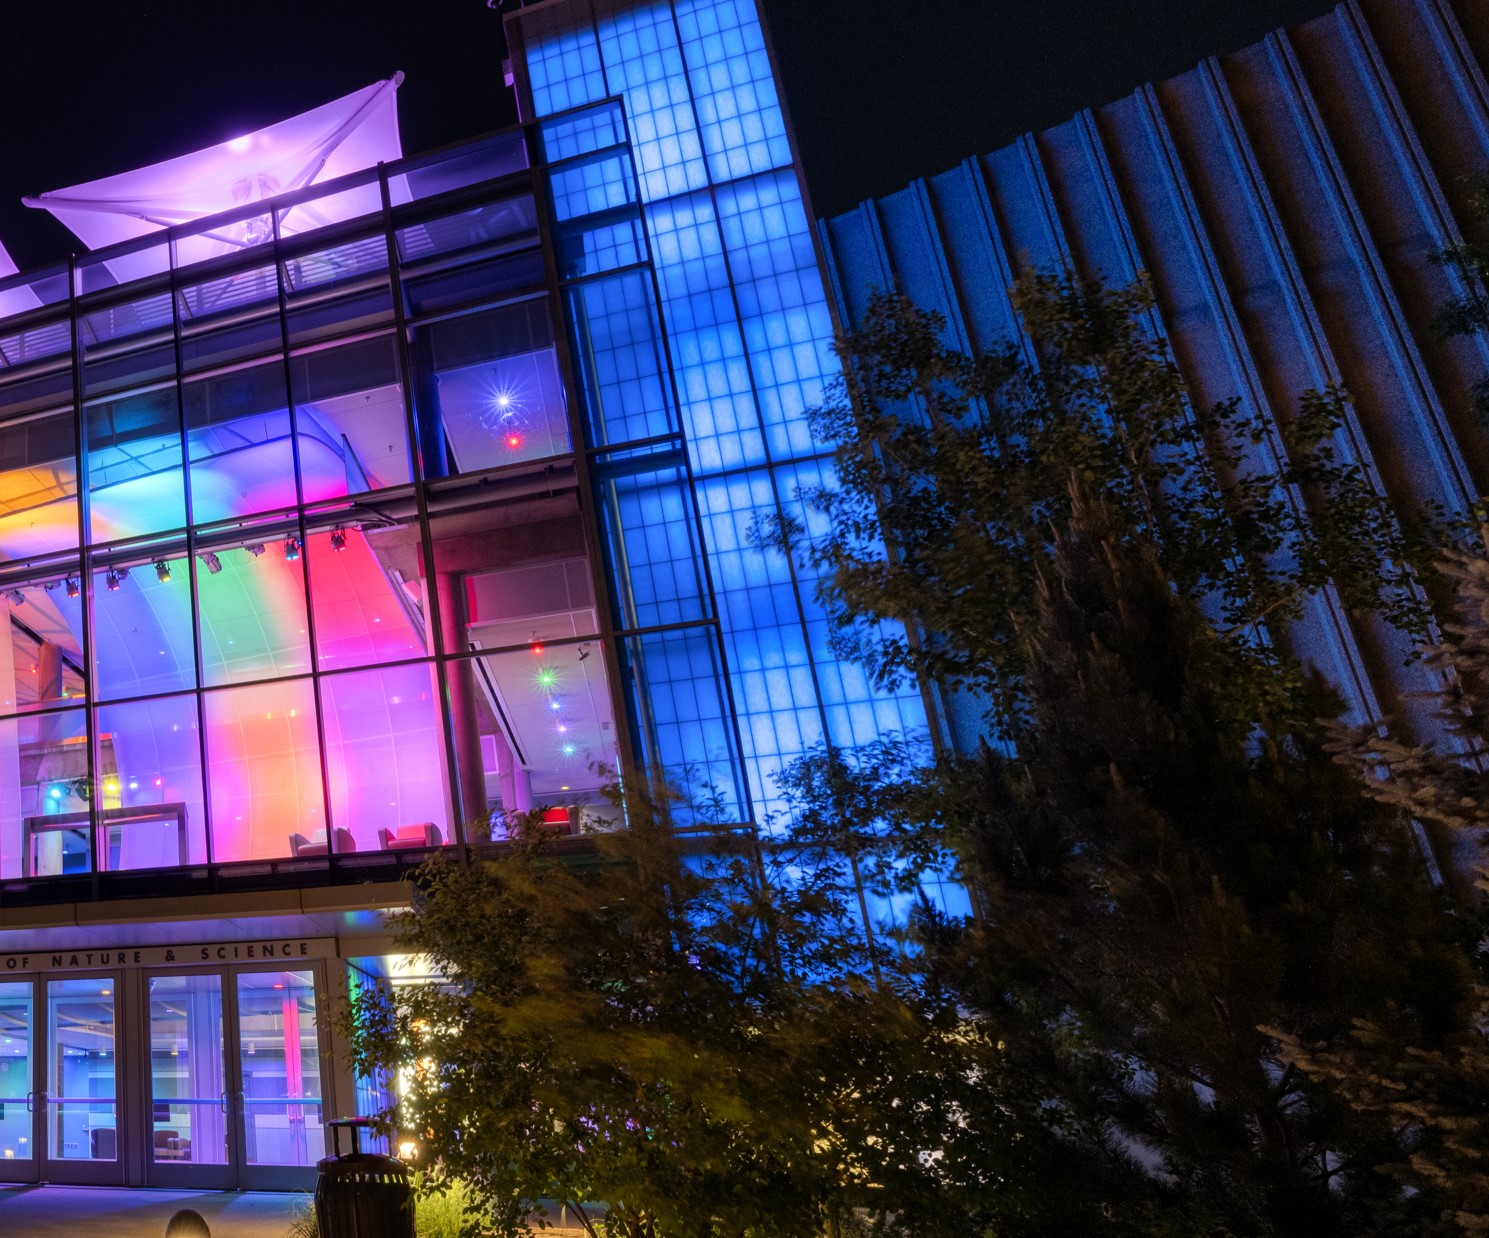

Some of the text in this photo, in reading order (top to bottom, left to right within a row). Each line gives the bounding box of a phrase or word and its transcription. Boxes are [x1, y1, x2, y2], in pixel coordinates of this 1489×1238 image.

[6, 957, 30, 969] OF
[51, 951, 141, 967] NATURE
[165, 949, 176, 961] &
[201, 942, 308, 960] SCIENCE
